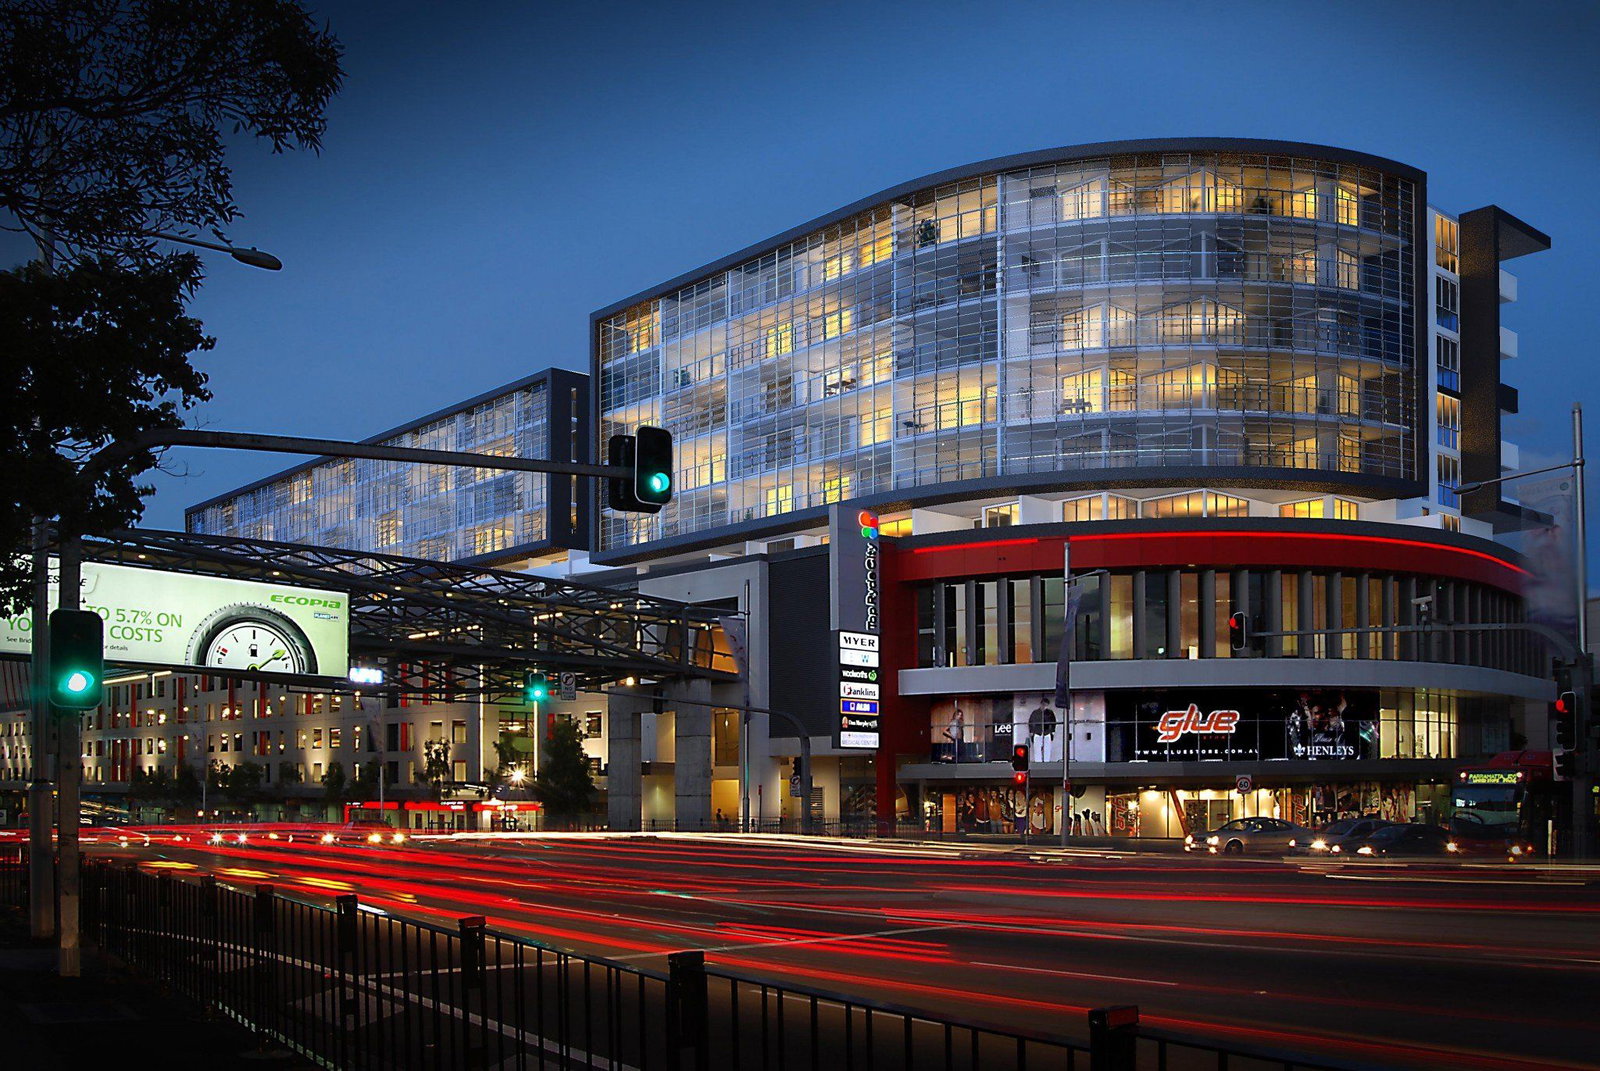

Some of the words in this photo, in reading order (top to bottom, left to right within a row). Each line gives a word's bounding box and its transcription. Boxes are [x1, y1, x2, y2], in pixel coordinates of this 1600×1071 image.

[116, 608, 152, 625] 5.7%
[156, 612, 182, 628] ON
[109, 625, 163, 643] COSTS
[843, 636, 876, 648] MYER
[994, 723, 1012, 734] Lee
[1157, 703, 1240, 743] glue
[1306, 745, 1355, 756] HENLEYS
[1238, 781, 1249, 789] 60
